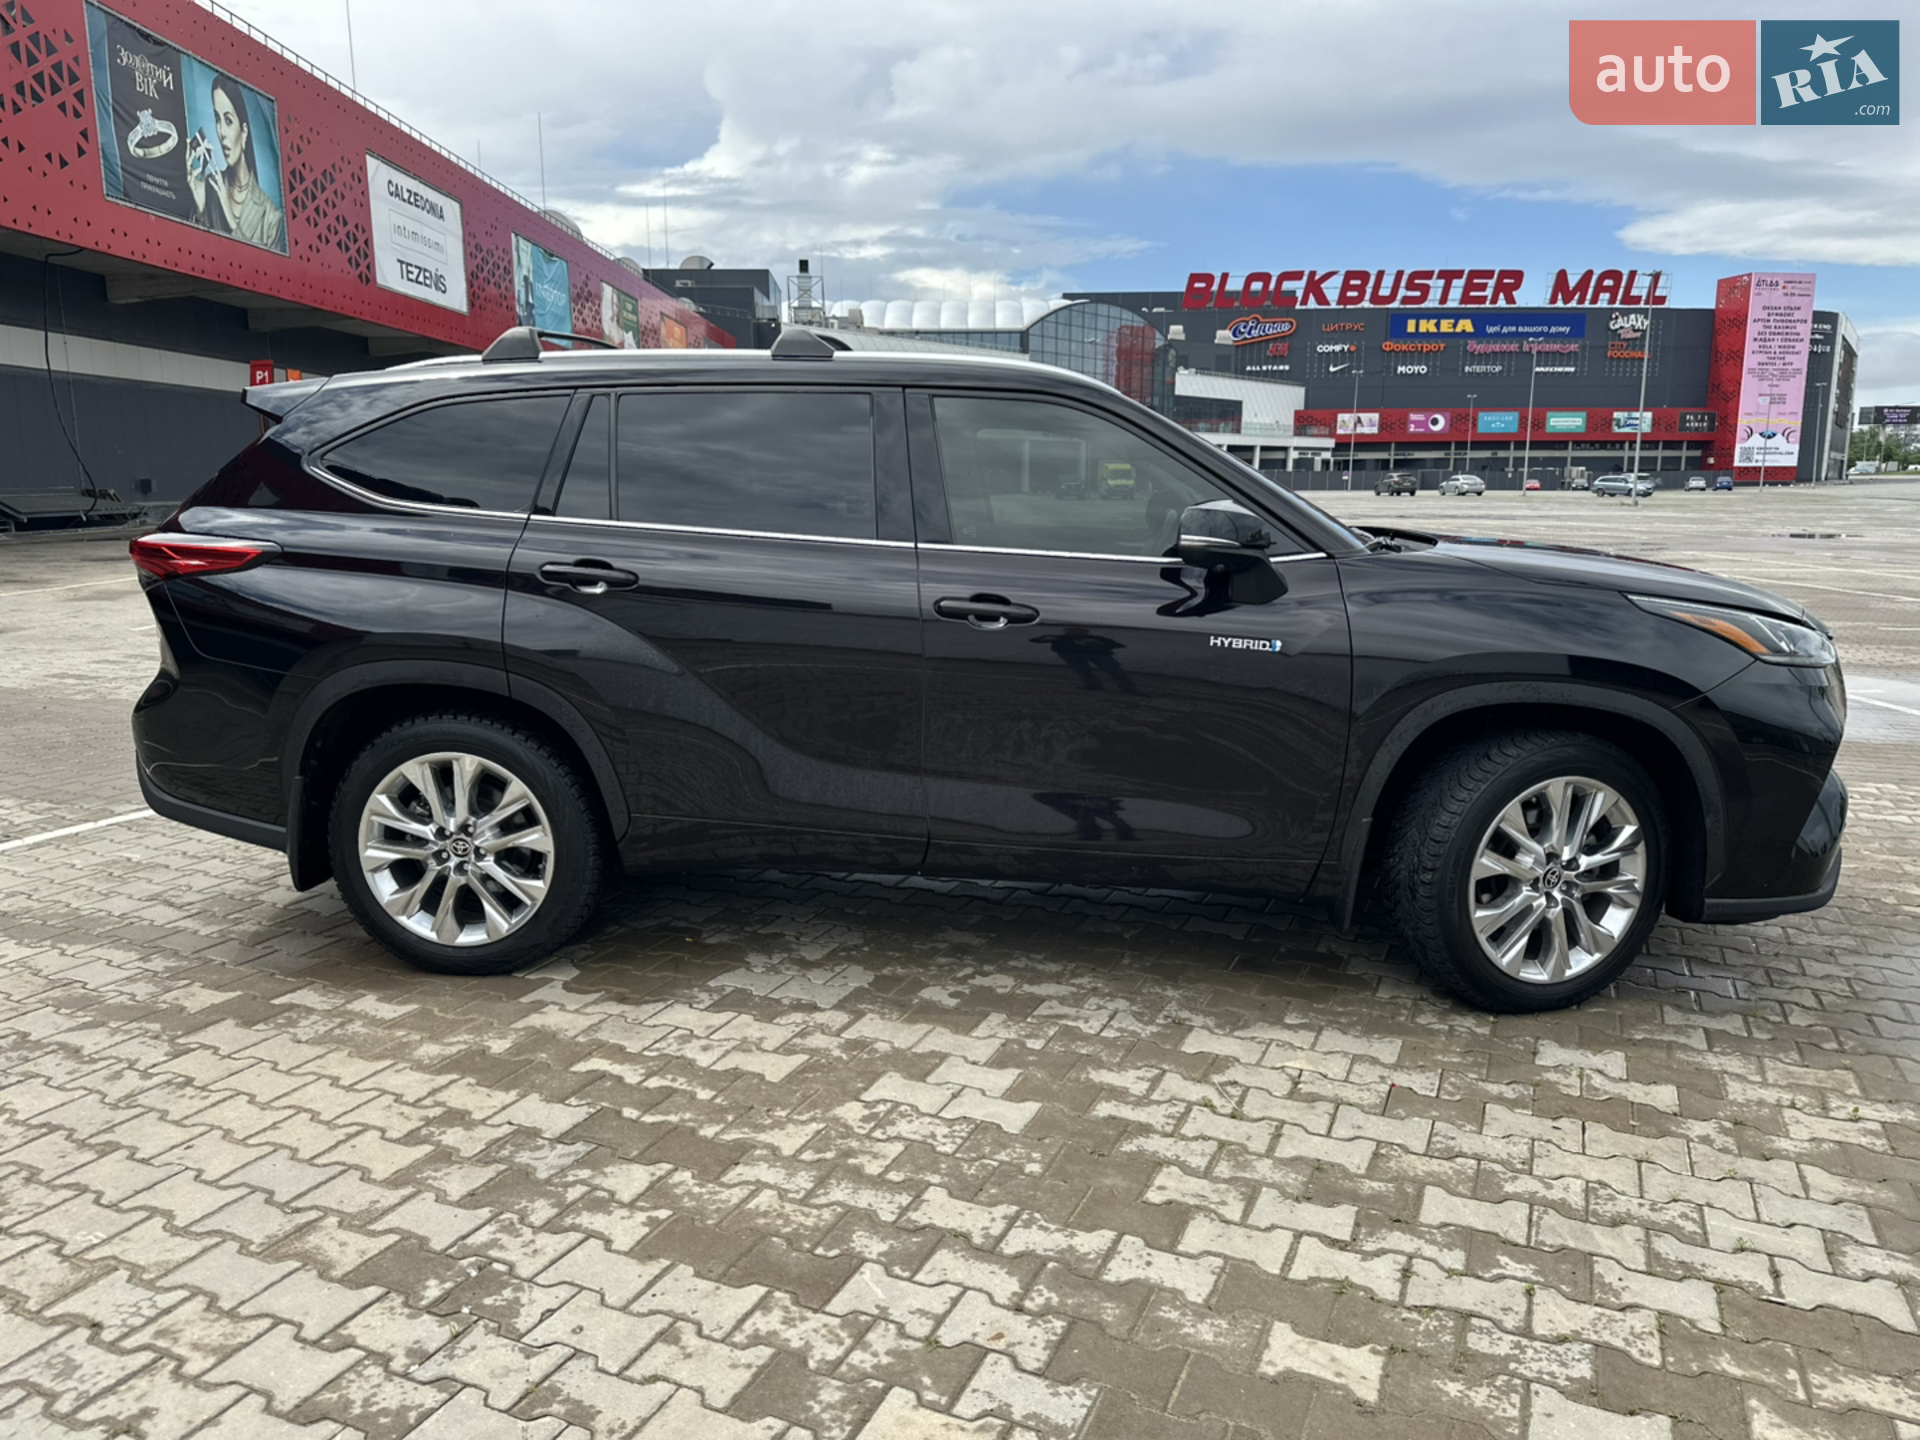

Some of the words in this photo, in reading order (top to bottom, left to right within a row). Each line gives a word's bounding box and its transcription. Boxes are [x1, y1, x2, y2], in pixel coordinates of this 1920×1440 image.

[135, 71, 159, 100] ВІК
[387, 179, 446, 222] CALZEDONIA
[393, 223, 445, 255] intimissimi
[397, 258, 448, 295] TEZENIS
[1181, 270, 1525, 309] BLOCKBUSTER
[1551, 269, 1668, 306] MALL
[1322, 322, 1365, 333] ЦИТРУС
[1406, 318, 1475, 333] IKEA
[1609, 312, 1650, 330] GALAXY
[1230, 319, 1292, 341] Сільпо
[1485, 324, 1501, 335] Ідеї
[1501, 326, 1517, 335] для
[1518, 325, 1549, 334] вашого
[1549, 326, 1572, 335] дому
[1316, 344, 1350, 353] COMFY
[1381, 341, 1446, 352] Фокстрот
[1608, 341, 1629, 350] CITY
[1397, 365, 1428, 375] MOYO
[1464, 365, 1502, 373] INTERTOP
[256, 370, 269, 384] P1
[1209, 635, 1271, 651] HYBRID
